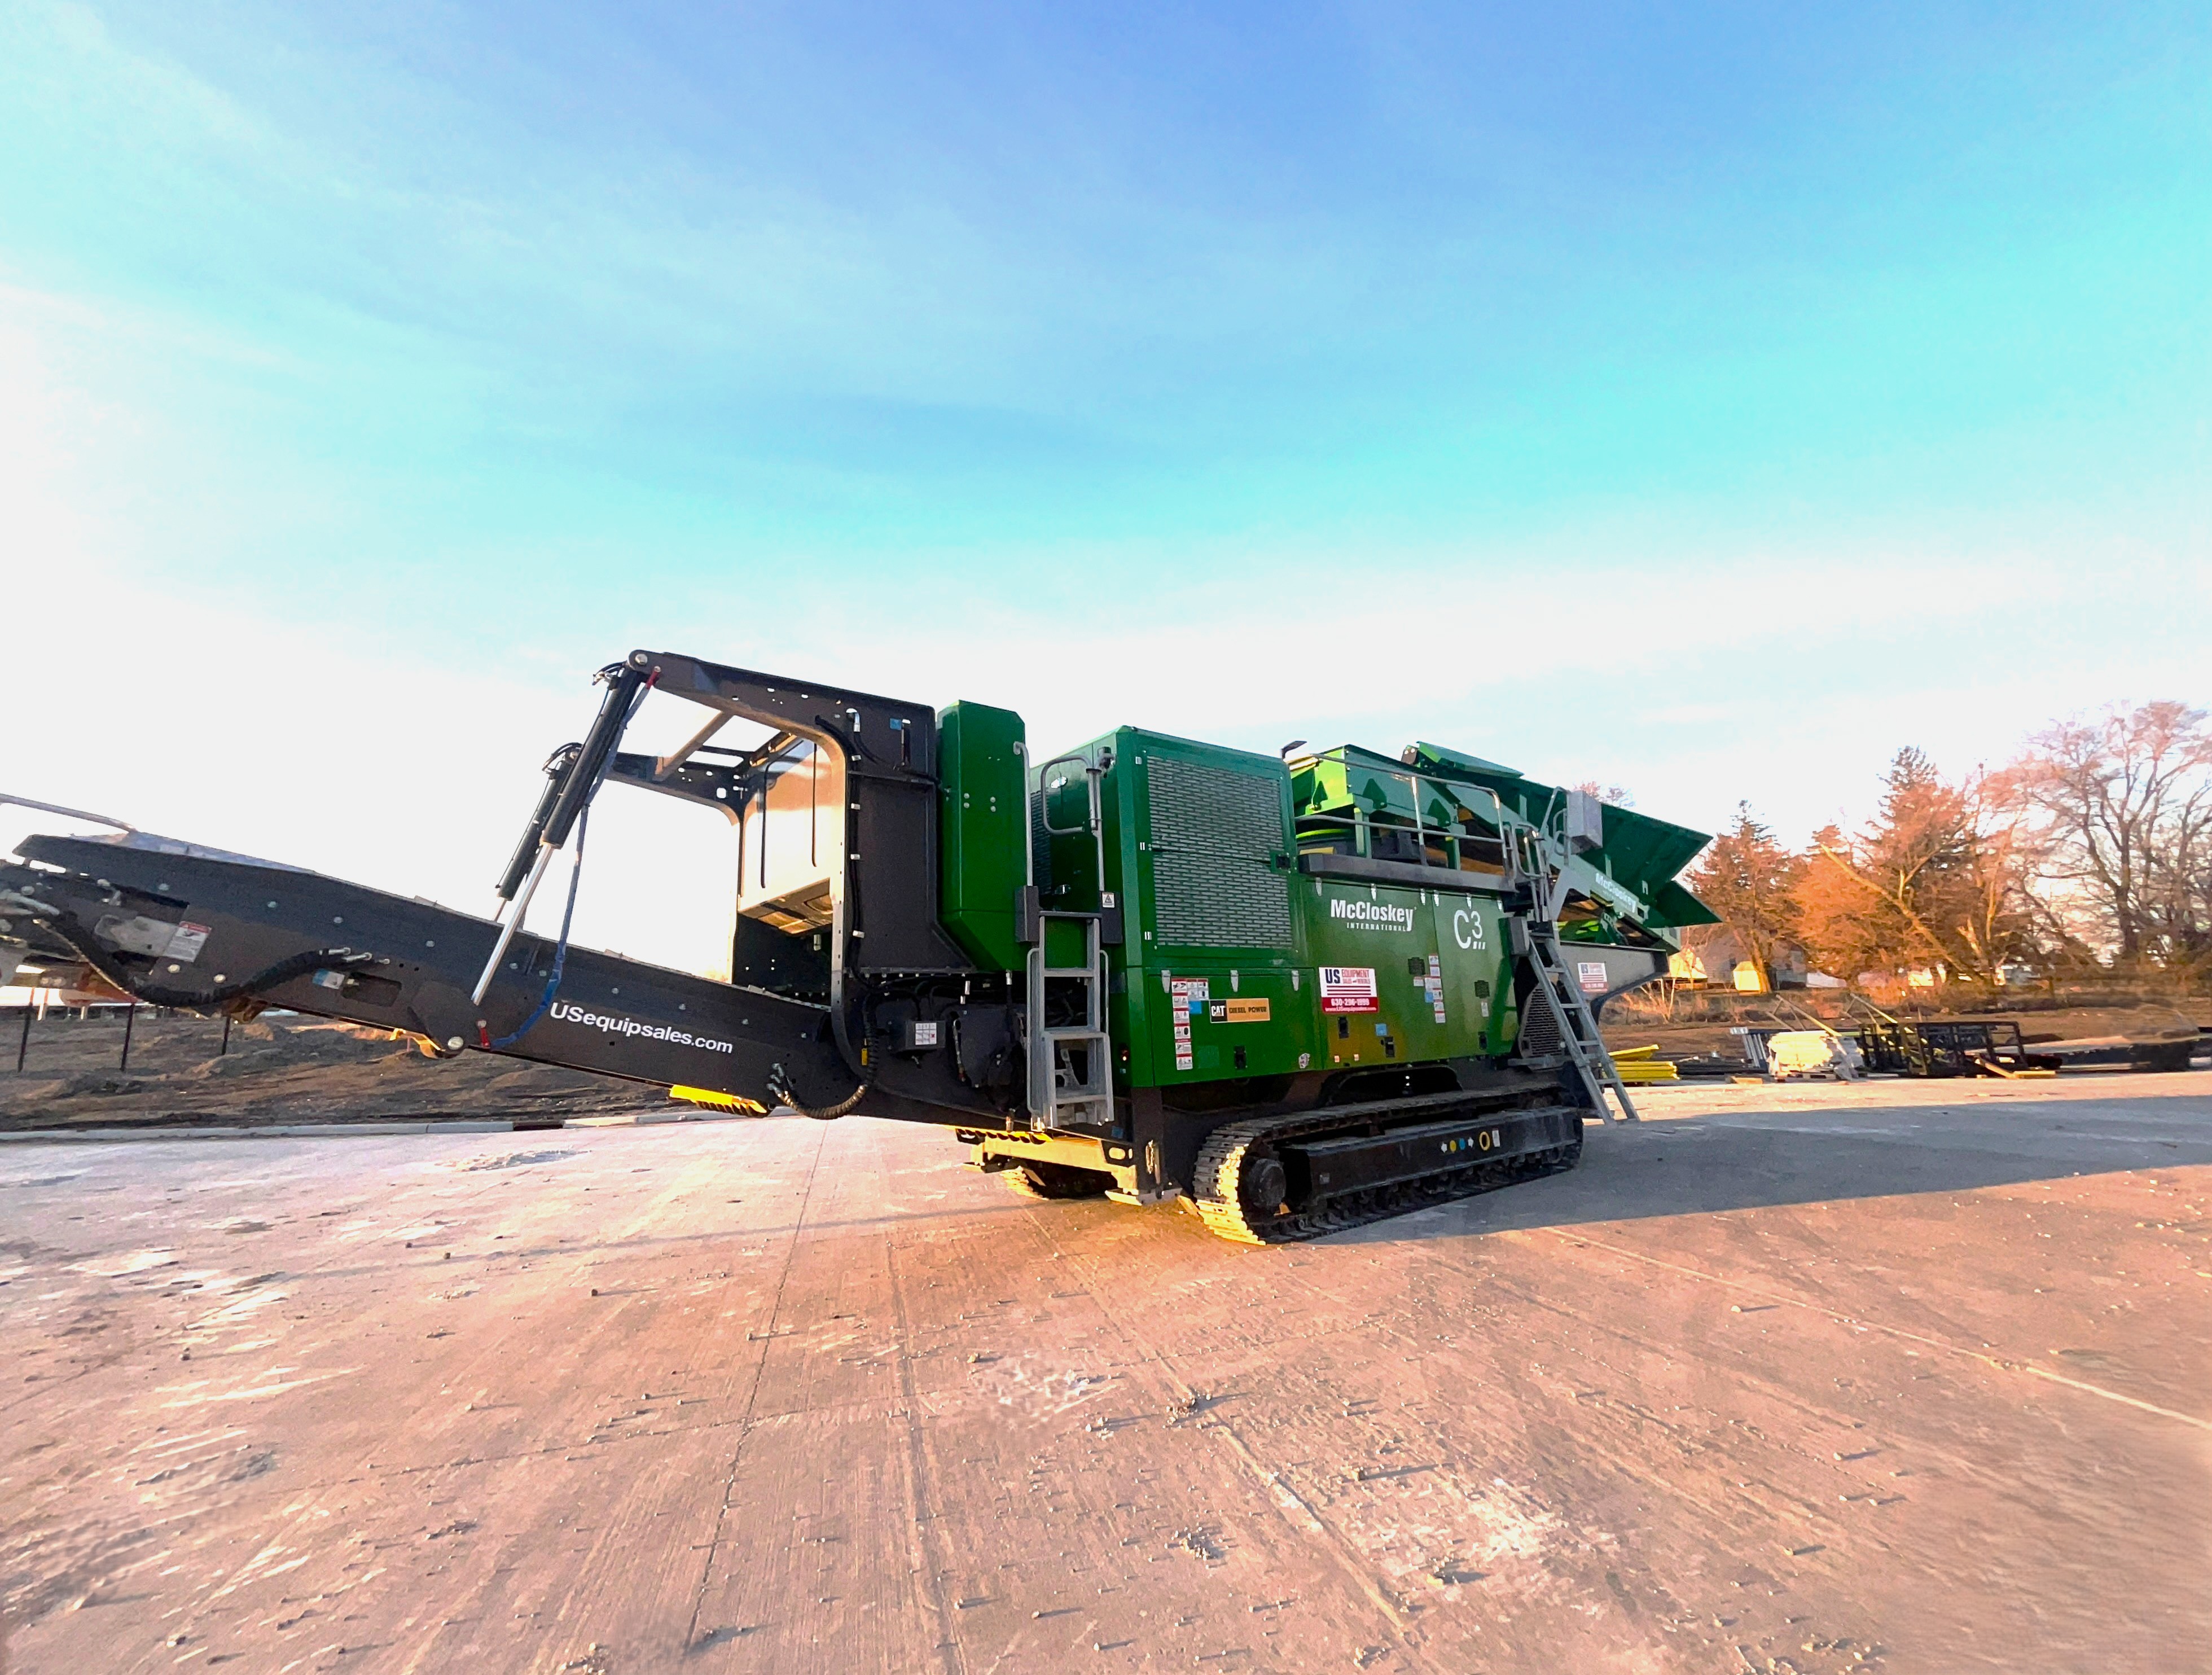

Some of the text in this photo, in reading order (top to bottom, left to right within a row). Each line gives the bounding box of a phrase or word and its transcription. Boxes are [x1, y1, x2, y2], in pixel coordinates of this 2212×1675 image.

[1331, 899, 1414, 932] McCloskey
[1346, 922, 1406, 932] INTERNATIONAL
[1325, 968, 1370, 984] US EQUIPMENT
[1211, 1005, 1226, 1016] CAT
[550, 1002, 733, 1054] USequipsales.com
